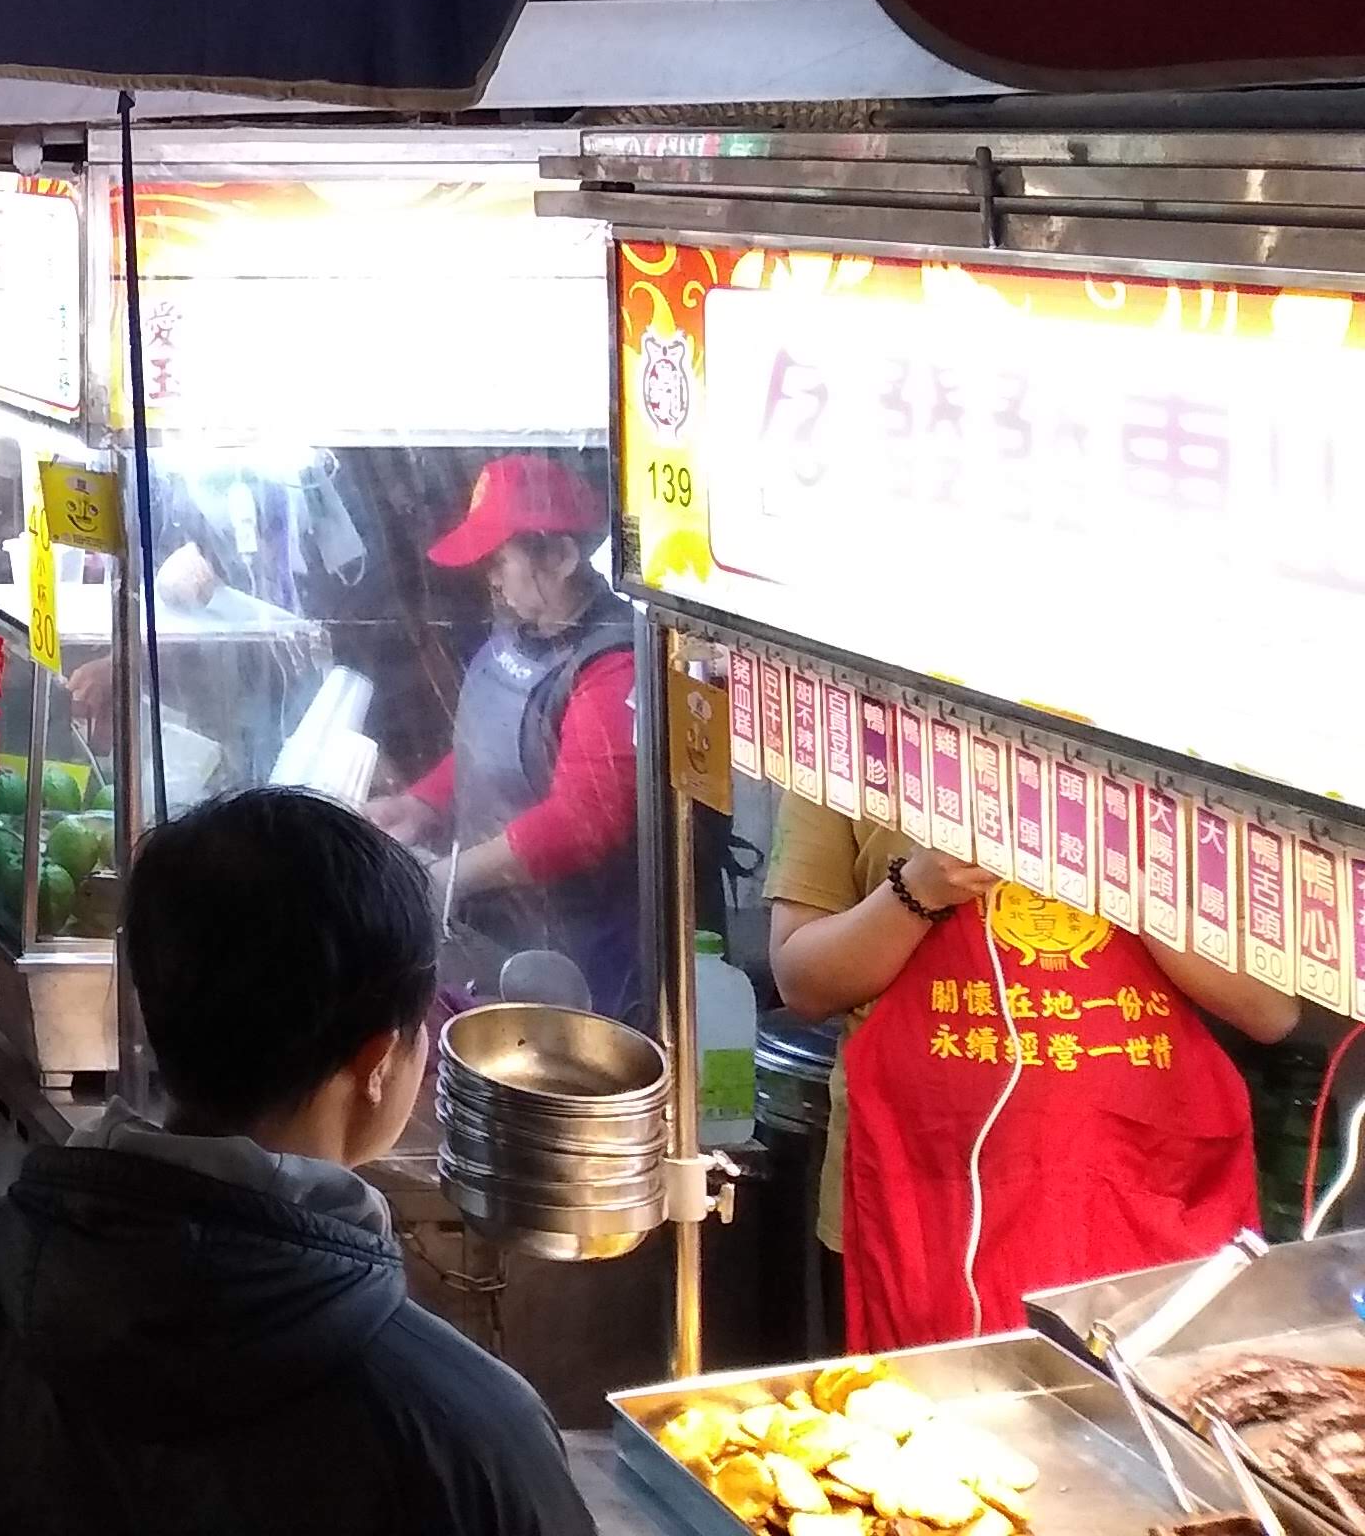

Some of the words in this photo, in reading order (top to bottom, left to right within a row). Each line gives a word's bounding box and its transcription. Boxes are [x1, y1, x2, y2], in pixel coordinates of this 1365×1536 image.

[647, 461, 693, 508] 139
[32, 606, 55, 660] 30
[732, 652, 754, 740] 豬血糕
[795, 678, 815, 753] 甜不辣
[933, 723, 962, 823] 雞翅
[1017, 757, 1042, 851] 鴨頭
[1148, 794, 1175, 903] 大腸頭
[1198, 819, 1226, 921] 大腸
[1249, 833, 1282, 947] 鴨舌頭
[1301, 848, 1338, 962] 鴨心
[1200, 929, 1227, 958] 20
[1254, 945, 1284, 978] 60
[1305, 963, 1336, 997] 30
[930, 979, 1171, 1021] 關懷在地一份心
[929, 1023, 1173, 1072] 永續經營一世情
